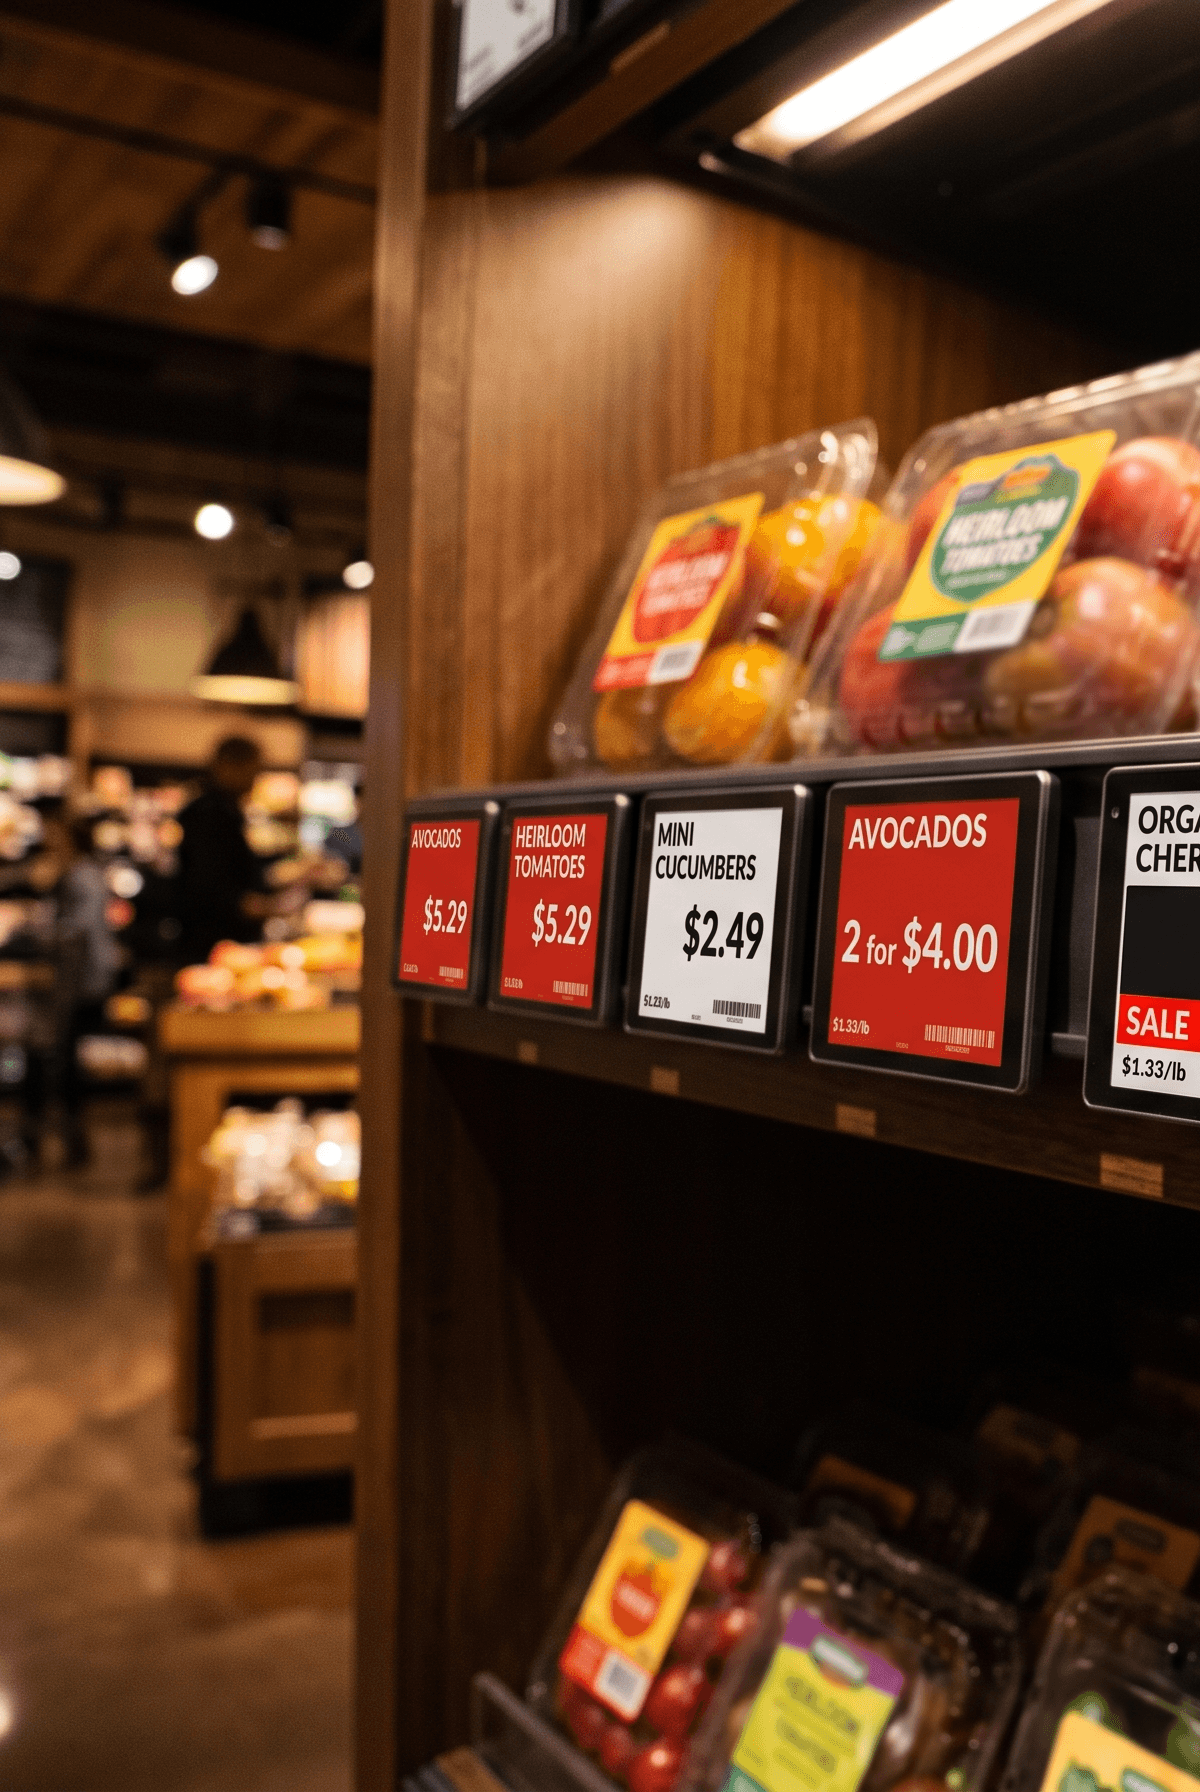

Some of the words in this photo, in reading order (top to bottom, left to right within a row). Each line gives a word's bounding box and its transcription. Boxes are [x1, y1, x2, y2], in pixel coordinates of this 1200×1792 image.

[411, 827, 462, 849] AVOCADOS
[515, 822, 586, 849] HEIRLOOM
[657, 821, 695, 848] MINI
[848, 813, 988, 850] AVOCADOS
[514, 854, 586, 880] TOMATOES
[655, 854, 757, 882] CUCUMBERS
[423, 895, 468, 936] $5.29
[531, 898, 592, 948] $5.29
[682, 904, 765, 962] $2.49
[841, 919, 861, 964] 2
[866, 934, 897, 966] for
[902, 916, 999, 974] $4.00
[832, 1016, 870, 1036] $1.33/lb
[1125, 1005, 1190, 1041] SALE
[1121, 1054, 1187, 1082] $1.33/lb
